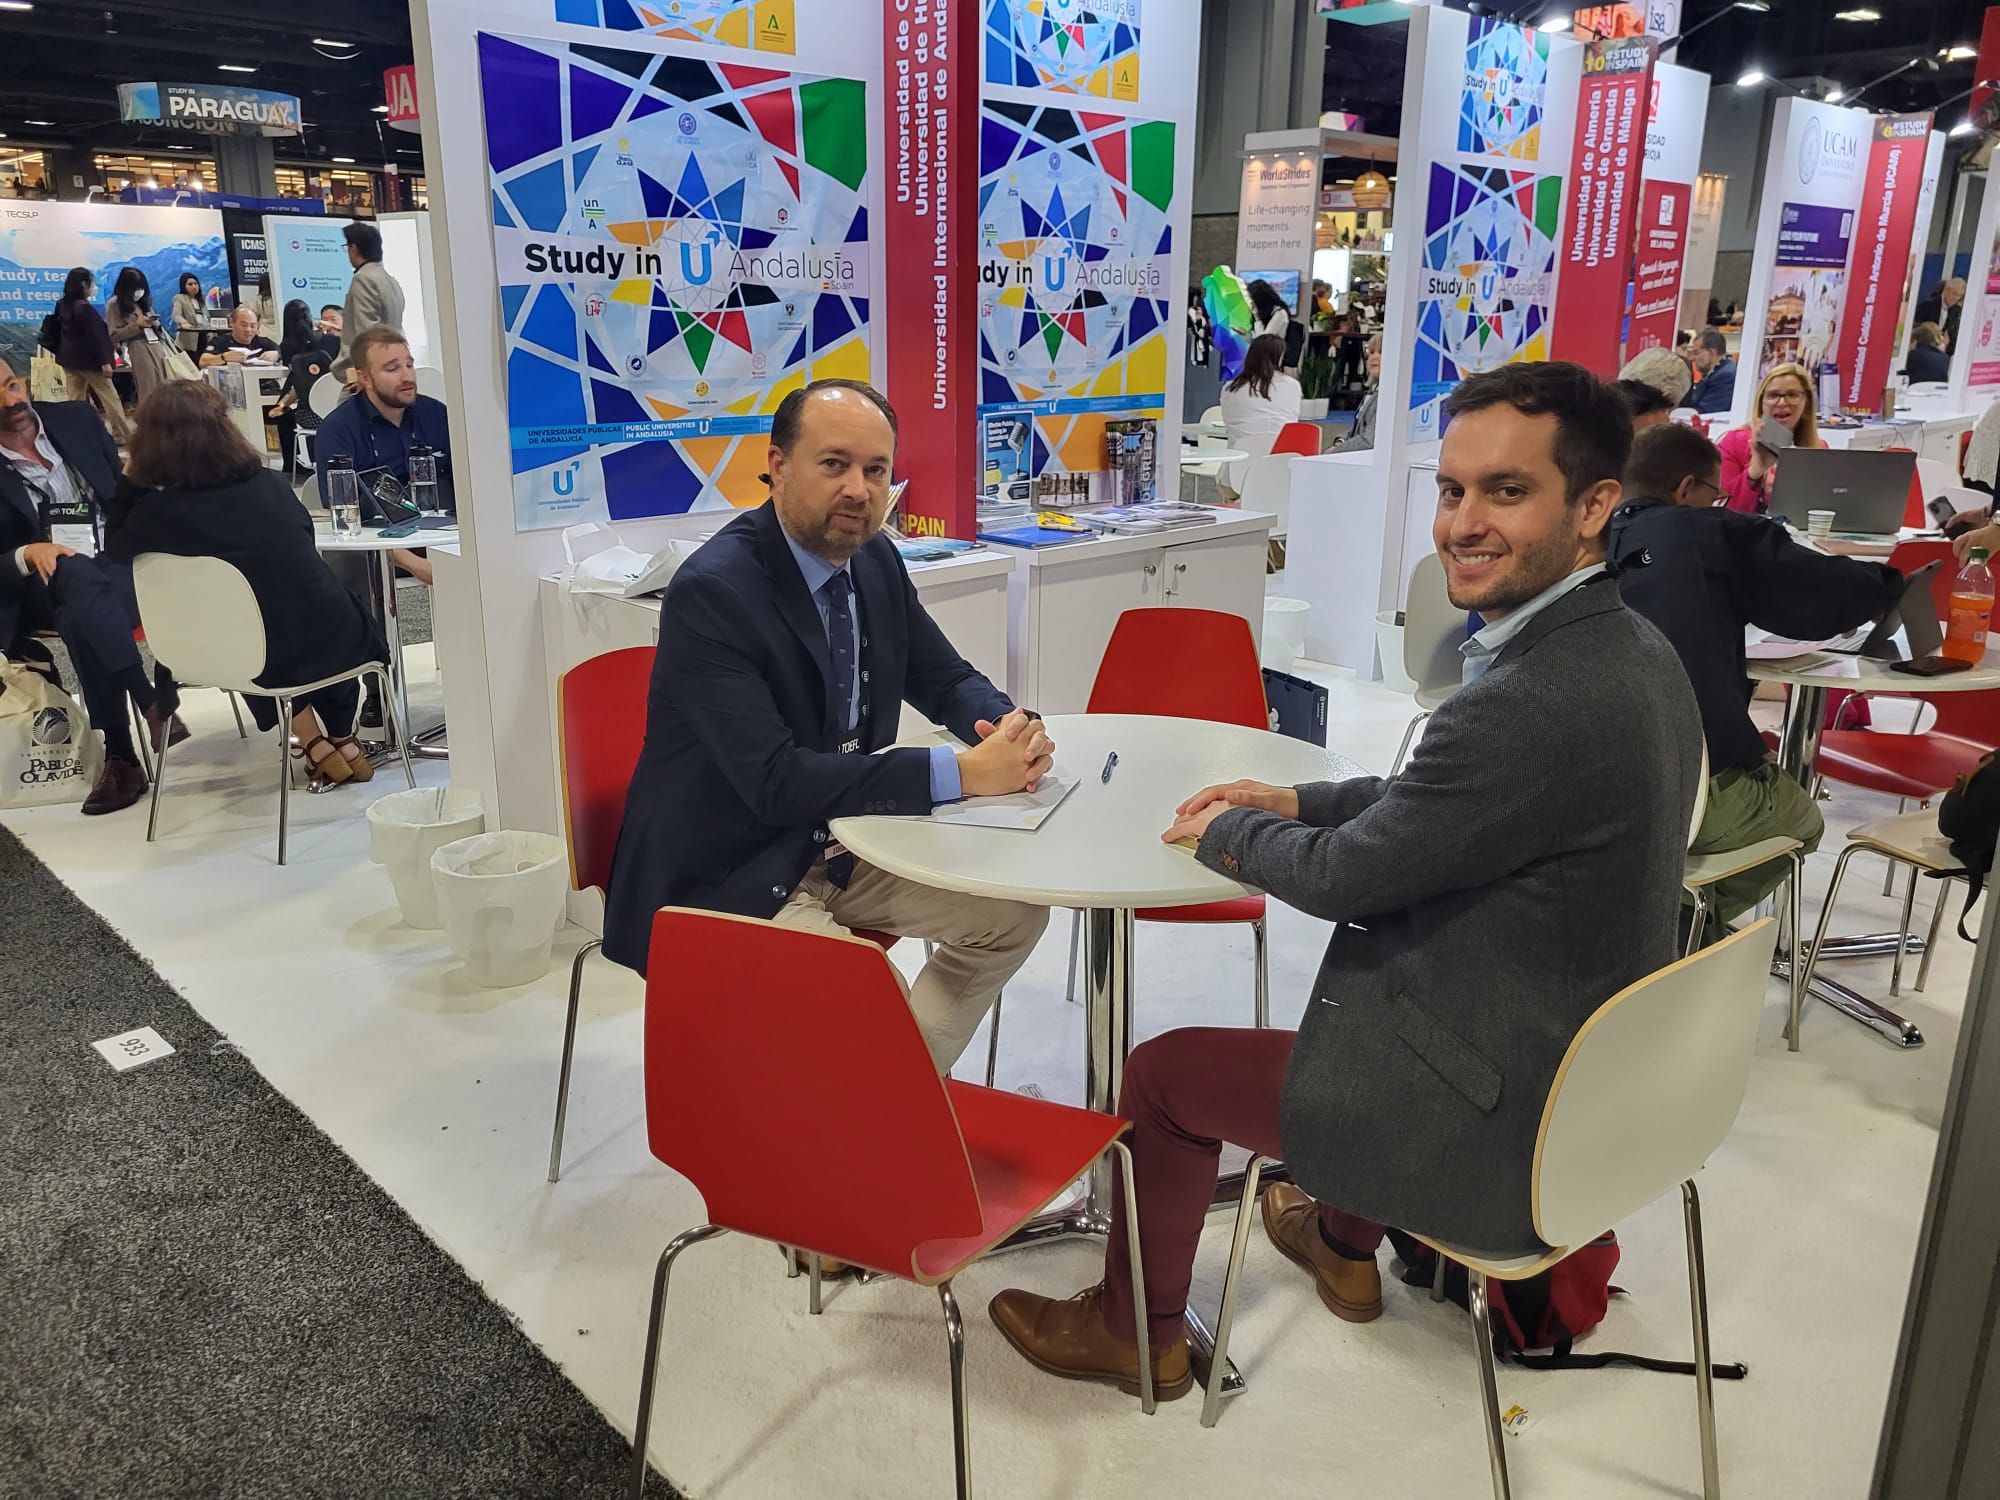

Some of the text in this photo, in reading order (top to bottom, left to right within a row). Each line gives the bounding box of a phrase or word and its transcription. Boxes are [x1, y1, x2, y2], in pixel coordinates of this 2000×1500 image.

[896, 20, 910, 51] de
[915, 32, 928, 64] de
[1606, 46, 1649, 60] #STUDY
[934, 68, 947, 100] de
[1466, 75, 1487, 92] Study
[169, 97, 289, 126] PARAGUAY
[896, 59, 910, 202] Universidad
[915, 72, 928, 215] Universidad
[1824, 130, 1857, 158] UCAM
[1260, 167, 1311, 181] WorldStrides
[1586, 88, 1619, 267] Universidad de Granada
[1603, 87, 1636, 258] Universidad de Málaga
[934, 108, 947, 267] Internacional
[5, 210, 39, 218] TECSUP
[1248, 203, 1310, 217] Life-changing
[1571, 176, 1592, 262] Universidad
[1582, 152, 1594, 171] de
[1877, 190, 1894, 227] Murcia
[1247, 222, 1289, 232] moments
[1876, 227, 1888, 242] de
[241, 239, 266, 251] ICMS
[1246, 238, 1304, 250] happen here.
[243, 259, 268, 267] STUDY
[525, 243, 624, 279] Study
[636, 246, 662, 275] in
[1869, 243, 1885, 282] Antonio
[0, 269, 68, 285] tudy, tea
[1016, 260, 1033, 283] in
[0, 288, 22, 301] nd
[831, 280, 854, 292] Spain
[1428, 278, 1463, 297] Study
[1466, 280, 1476, 295] in
[1865, 283, 1878, 304] San
[0, 310, 11, 320] n
[934, 275, 947, 409] Universidad
[1848, 346, 1866, 403] Universidad
[528, 425, 622, 438] UNIVERSIDADES PÚBLICAS
[626, 421, 696, 433] PUBLIC UNIVERSITIES
[635, 430, 674, 438] ANDALUSIA
[541, 435, 583, 444] ANDALUCÍA
[1141, 431, 1154, 501] DEGREES
[841, 738, 860, 755] TOEFL
[20, 765, 85, 783] OLAVIDE
[30, 758, 74, 773] PABLO
[119, 1038, 151, 1057] 933
